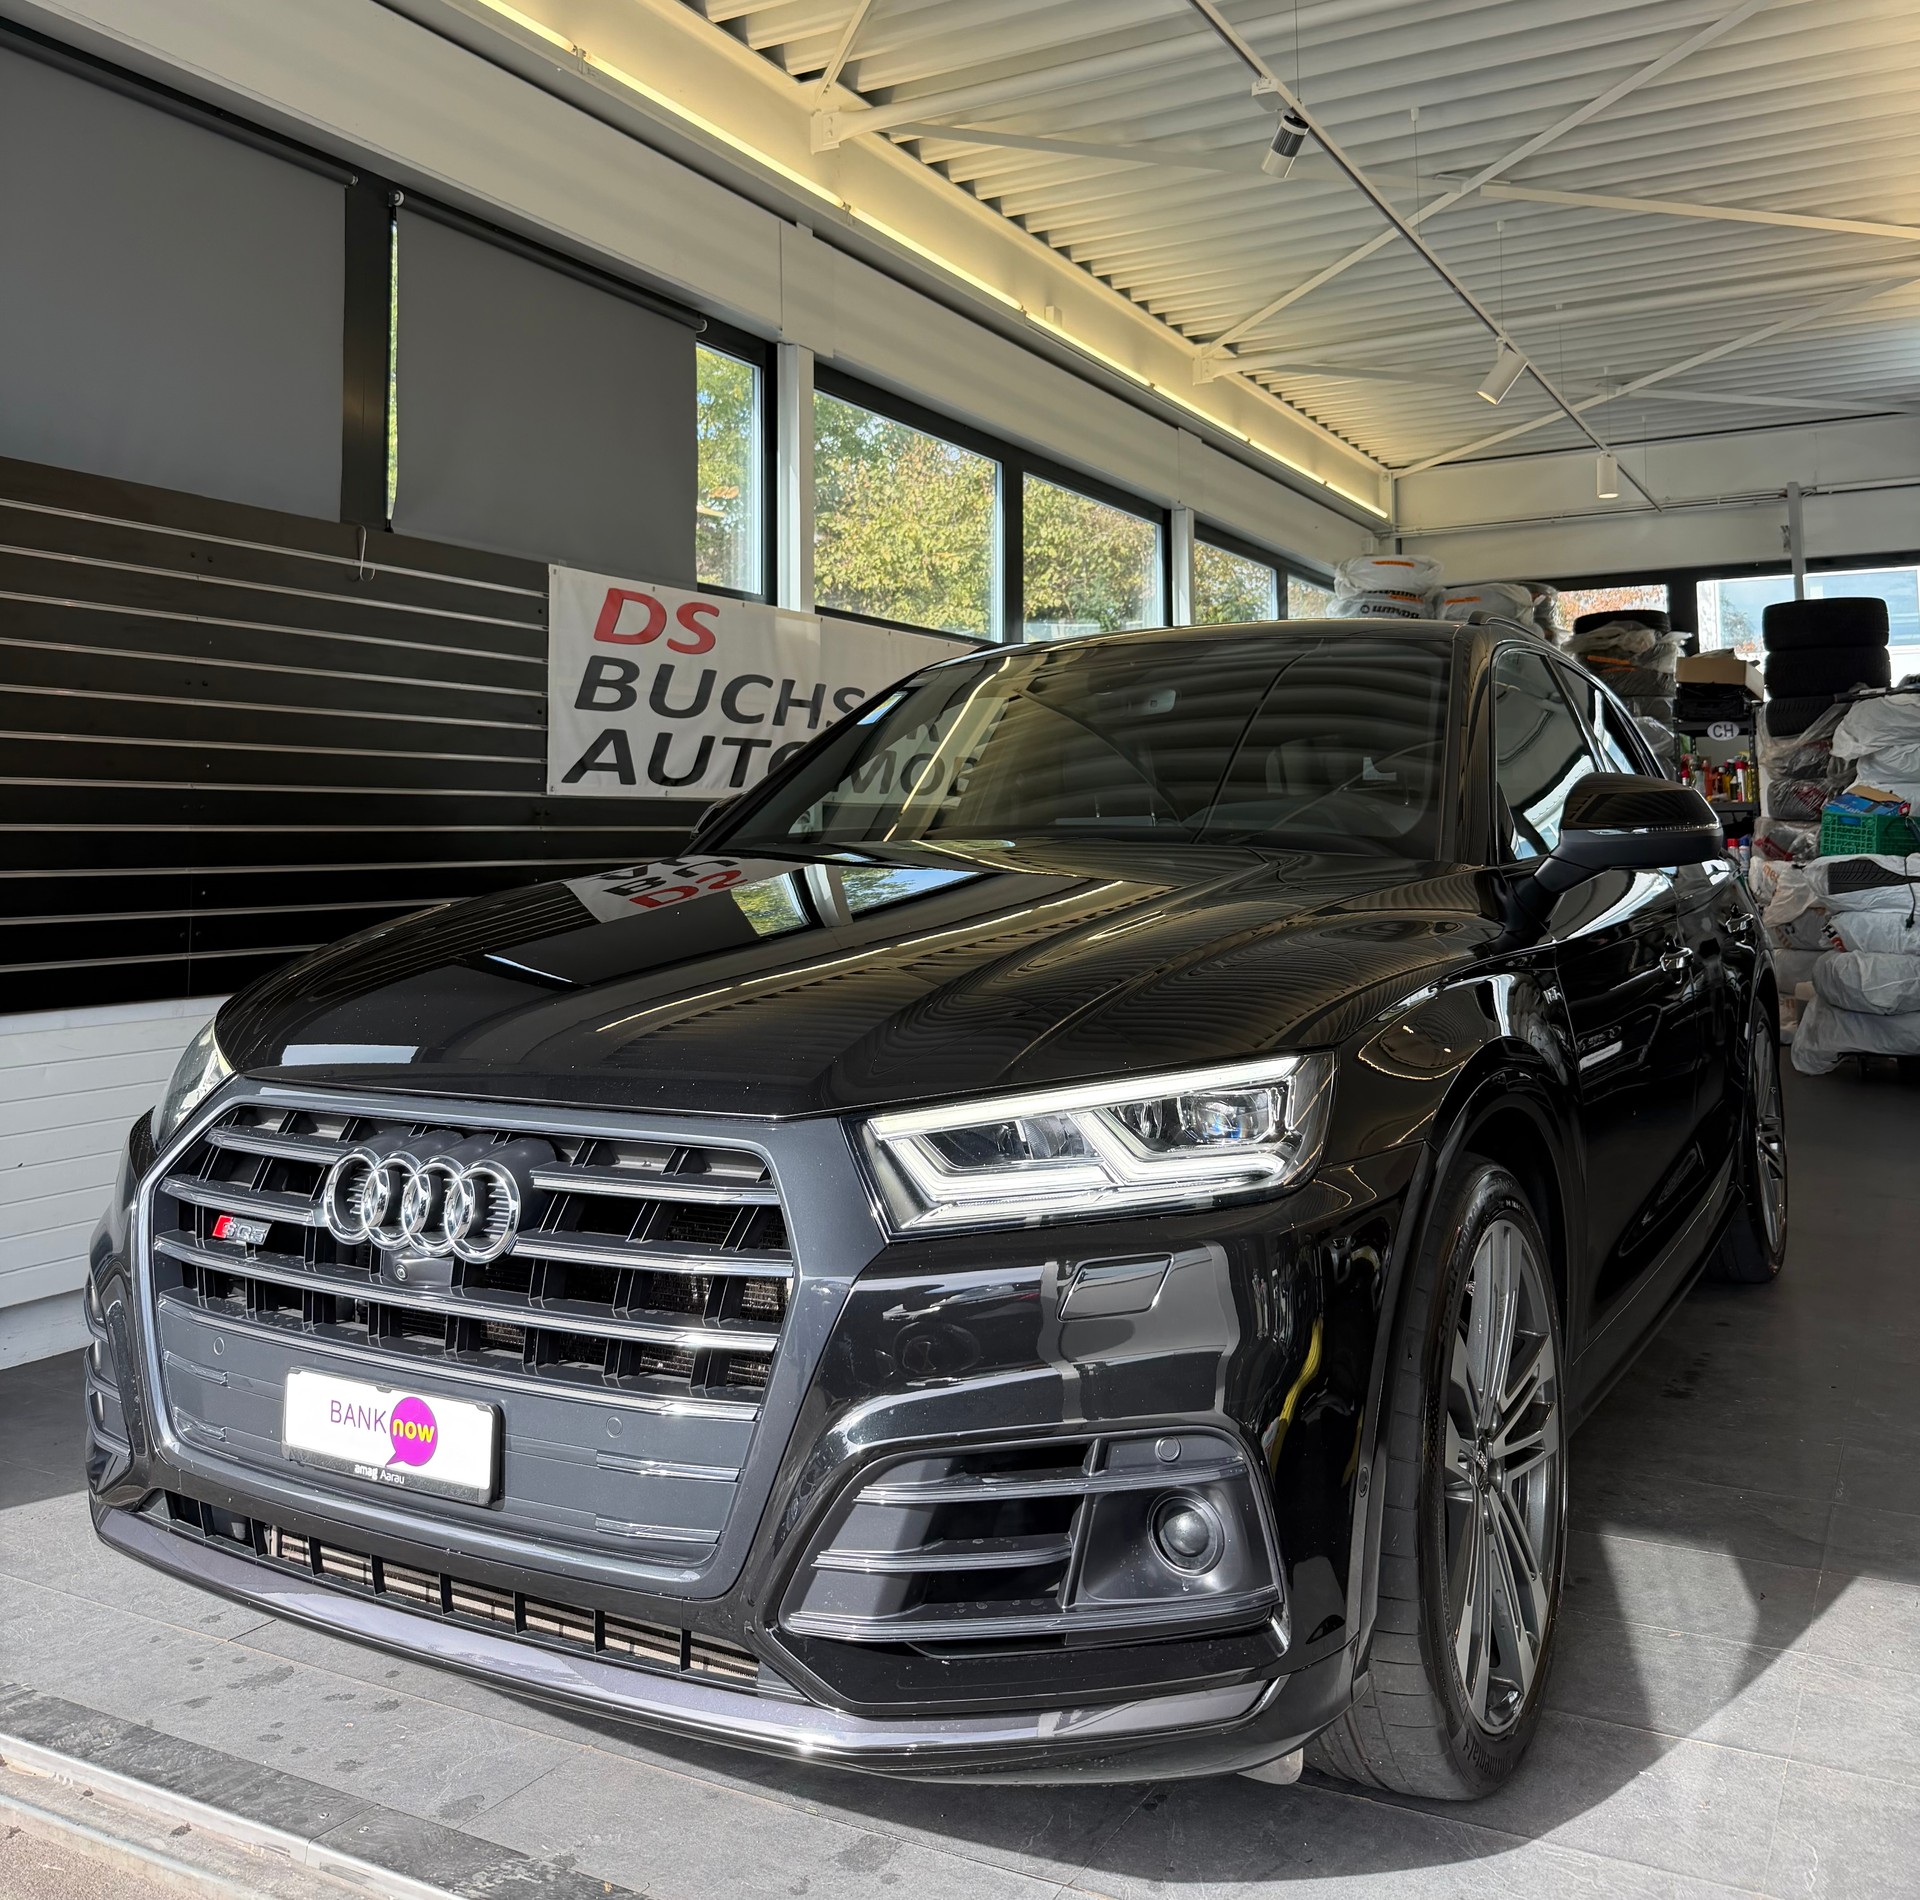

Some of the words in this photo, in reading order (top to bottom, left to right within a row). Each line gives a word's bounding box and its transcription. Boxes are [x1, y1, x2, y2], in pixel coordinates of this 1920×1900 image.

[593, 587, 720, 654] DS
[1712, 724, 1735, 738] CH
[329, 1399, 388, 1434] BANK
[391, 1417, 436, 1444] now
[354, 1463, 379, 1481] amag
[379, 1469, 405, 1485] Aarau
